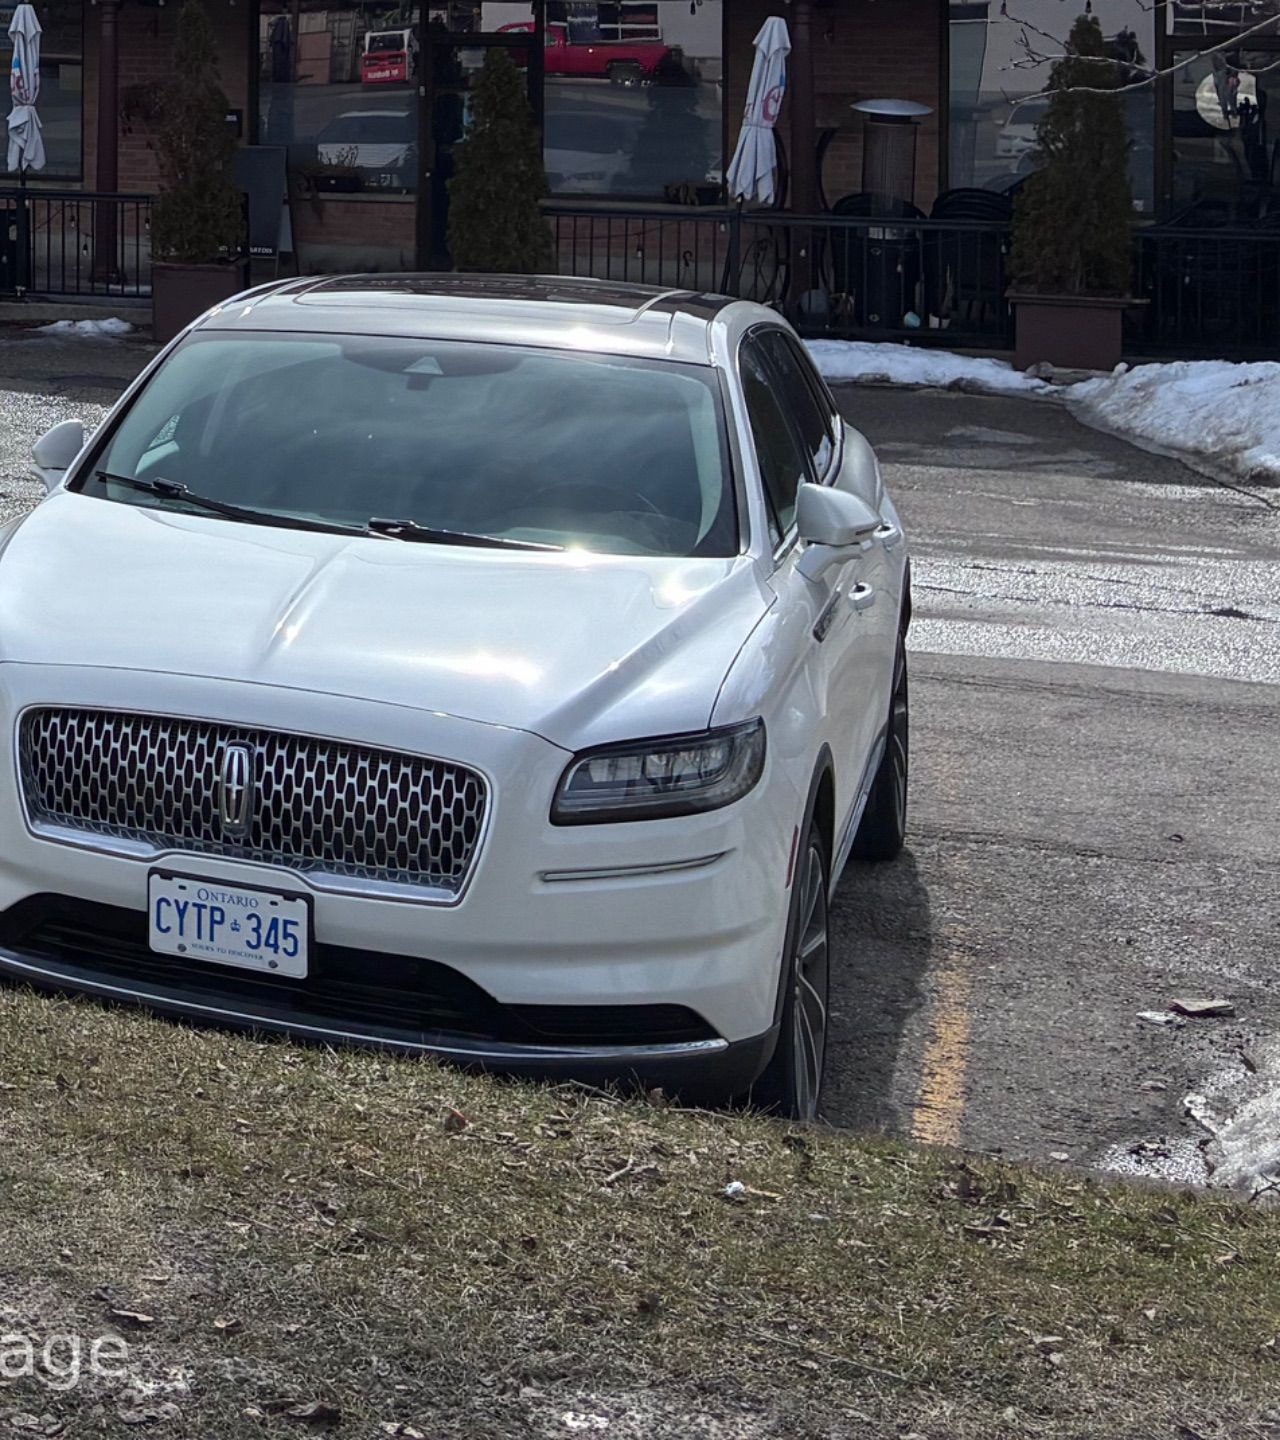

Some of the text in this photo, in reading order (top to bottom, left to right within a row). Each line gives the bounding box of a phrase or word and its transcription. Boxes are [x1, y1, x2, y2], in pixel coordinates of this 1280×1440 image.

[196, 888, 259, 909] ONTARIO
[155, 897, 300, 957] CYTP 345
